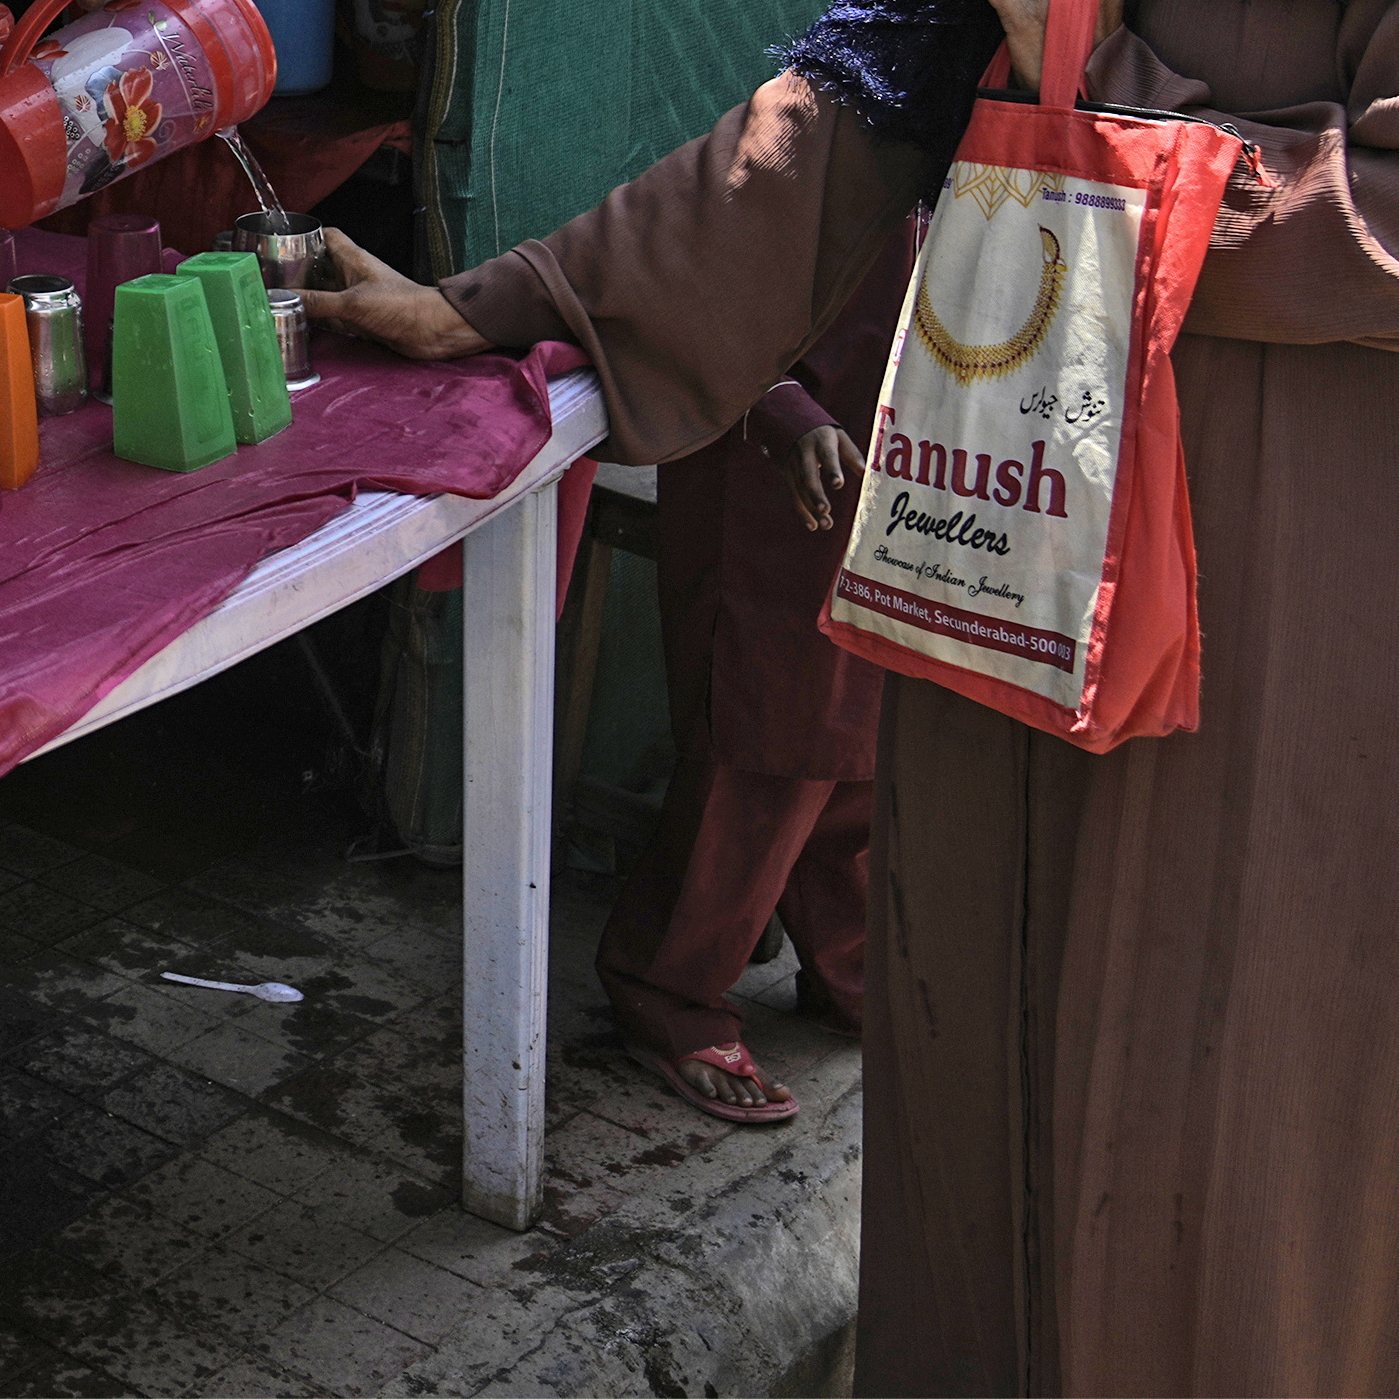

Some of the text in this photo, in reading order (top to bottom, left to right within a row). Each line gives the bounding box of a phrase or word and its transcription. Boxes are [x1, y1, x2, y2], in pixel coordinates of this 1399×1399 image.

[1042, 187, 1067, 202] Tanush
[871, 404, 1069, 519] Tanush
[885, 491, 1011, 557] Jewellers
[874, 545, 1025, 608] Showcase of Indian Jewellery
[874, 589, 892, 608] Pot
[892, 597, 933, 624] Market,
